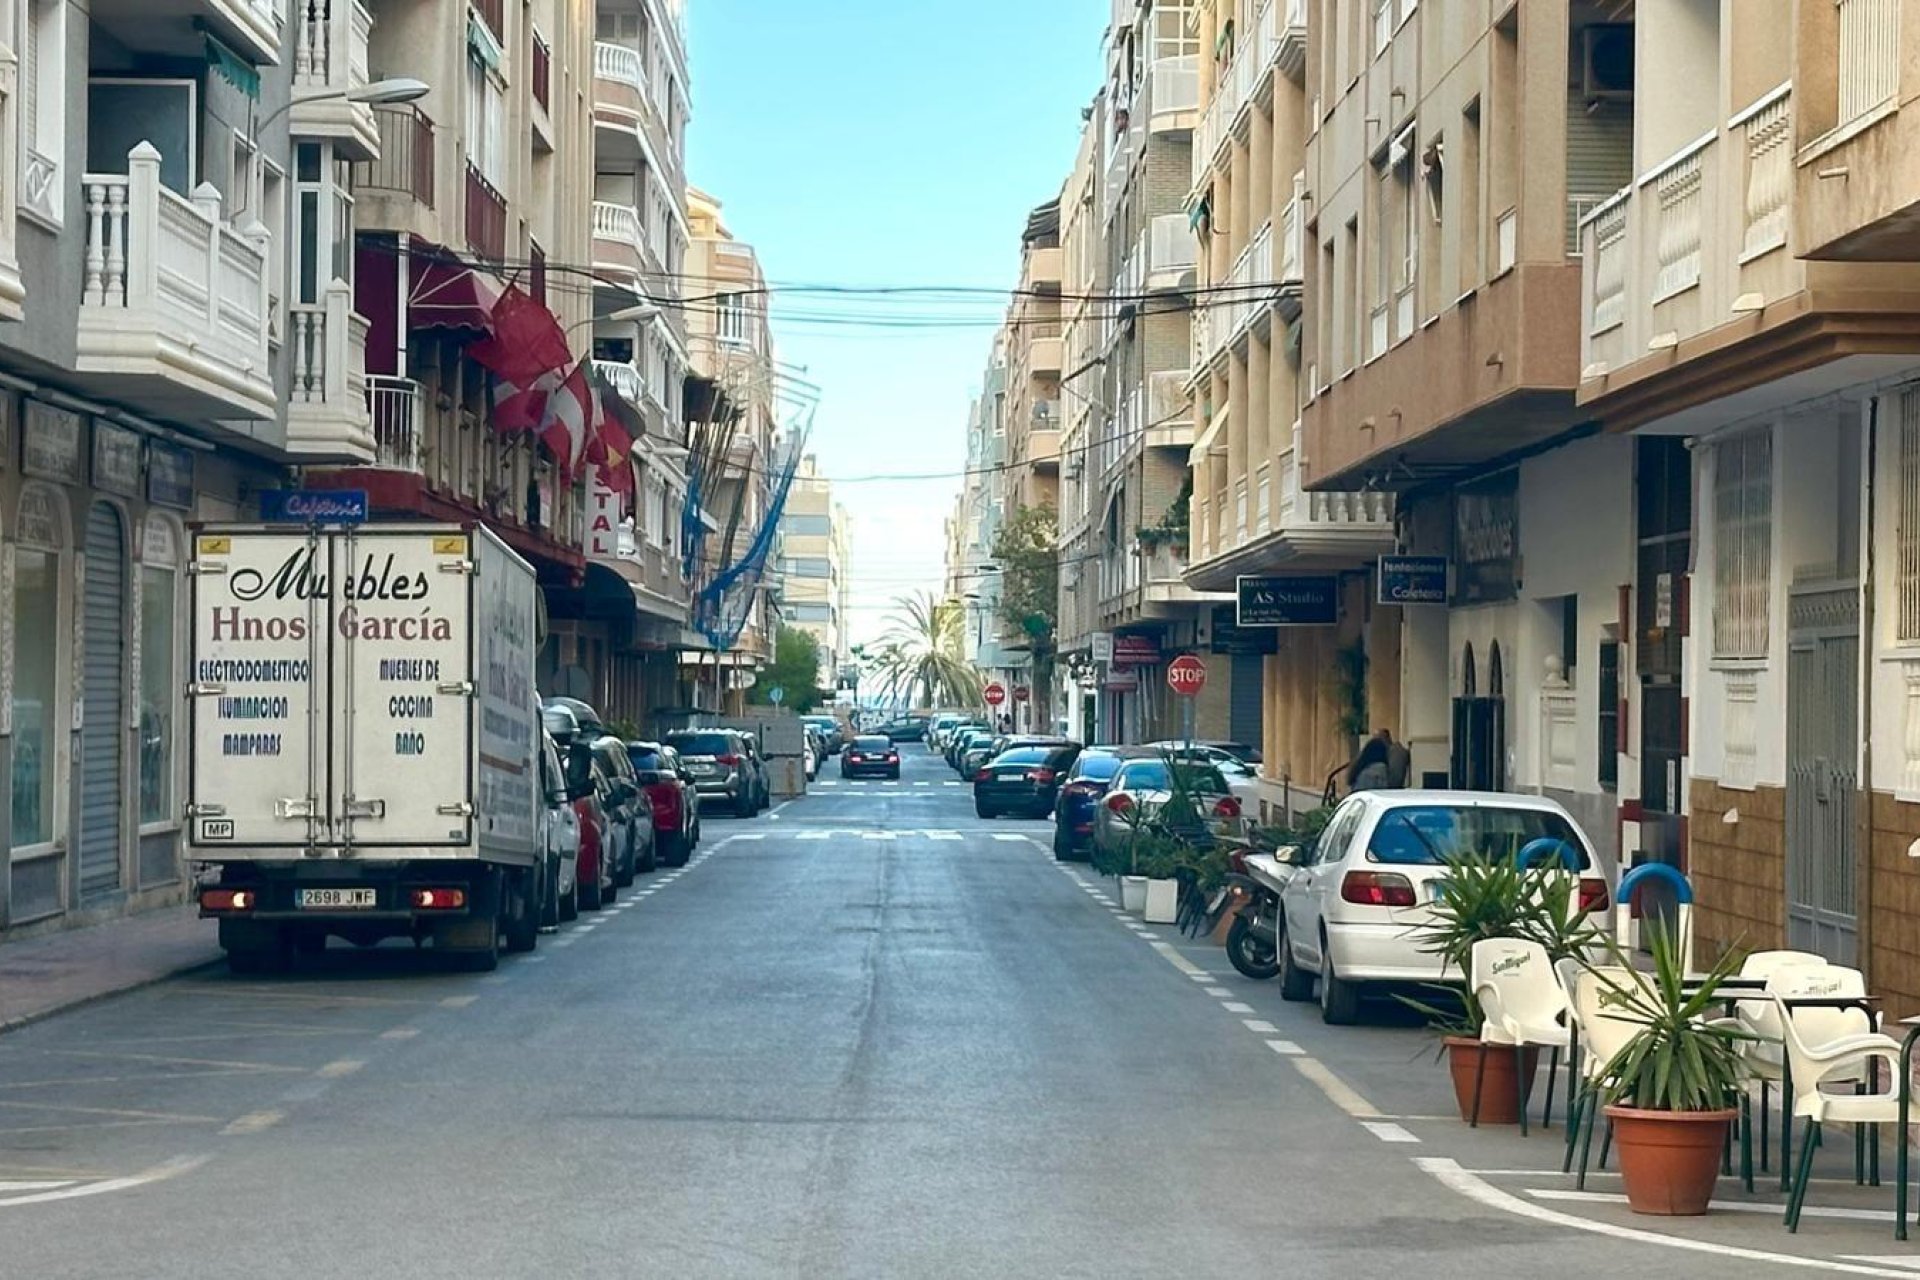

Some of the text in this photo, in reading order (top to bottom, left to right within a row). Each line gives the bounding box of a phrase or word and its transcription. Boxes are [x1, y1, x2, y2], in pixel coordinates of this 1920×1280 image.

[1253, 592, 1275, 604] AS
[211, 606, 306, 641] Hnos
[338, 605, 452, 641] García
[379, 659, 440, 681] MUEBLES DE
[1171, 669, 1203, 682] STOP
[388, 696, 433, 718] COCINA
[222, 734, 282, 756] MAMPARAS
[207, 822, 232, 836] MP
[304, 890, 373, 906] 2698 JWF
